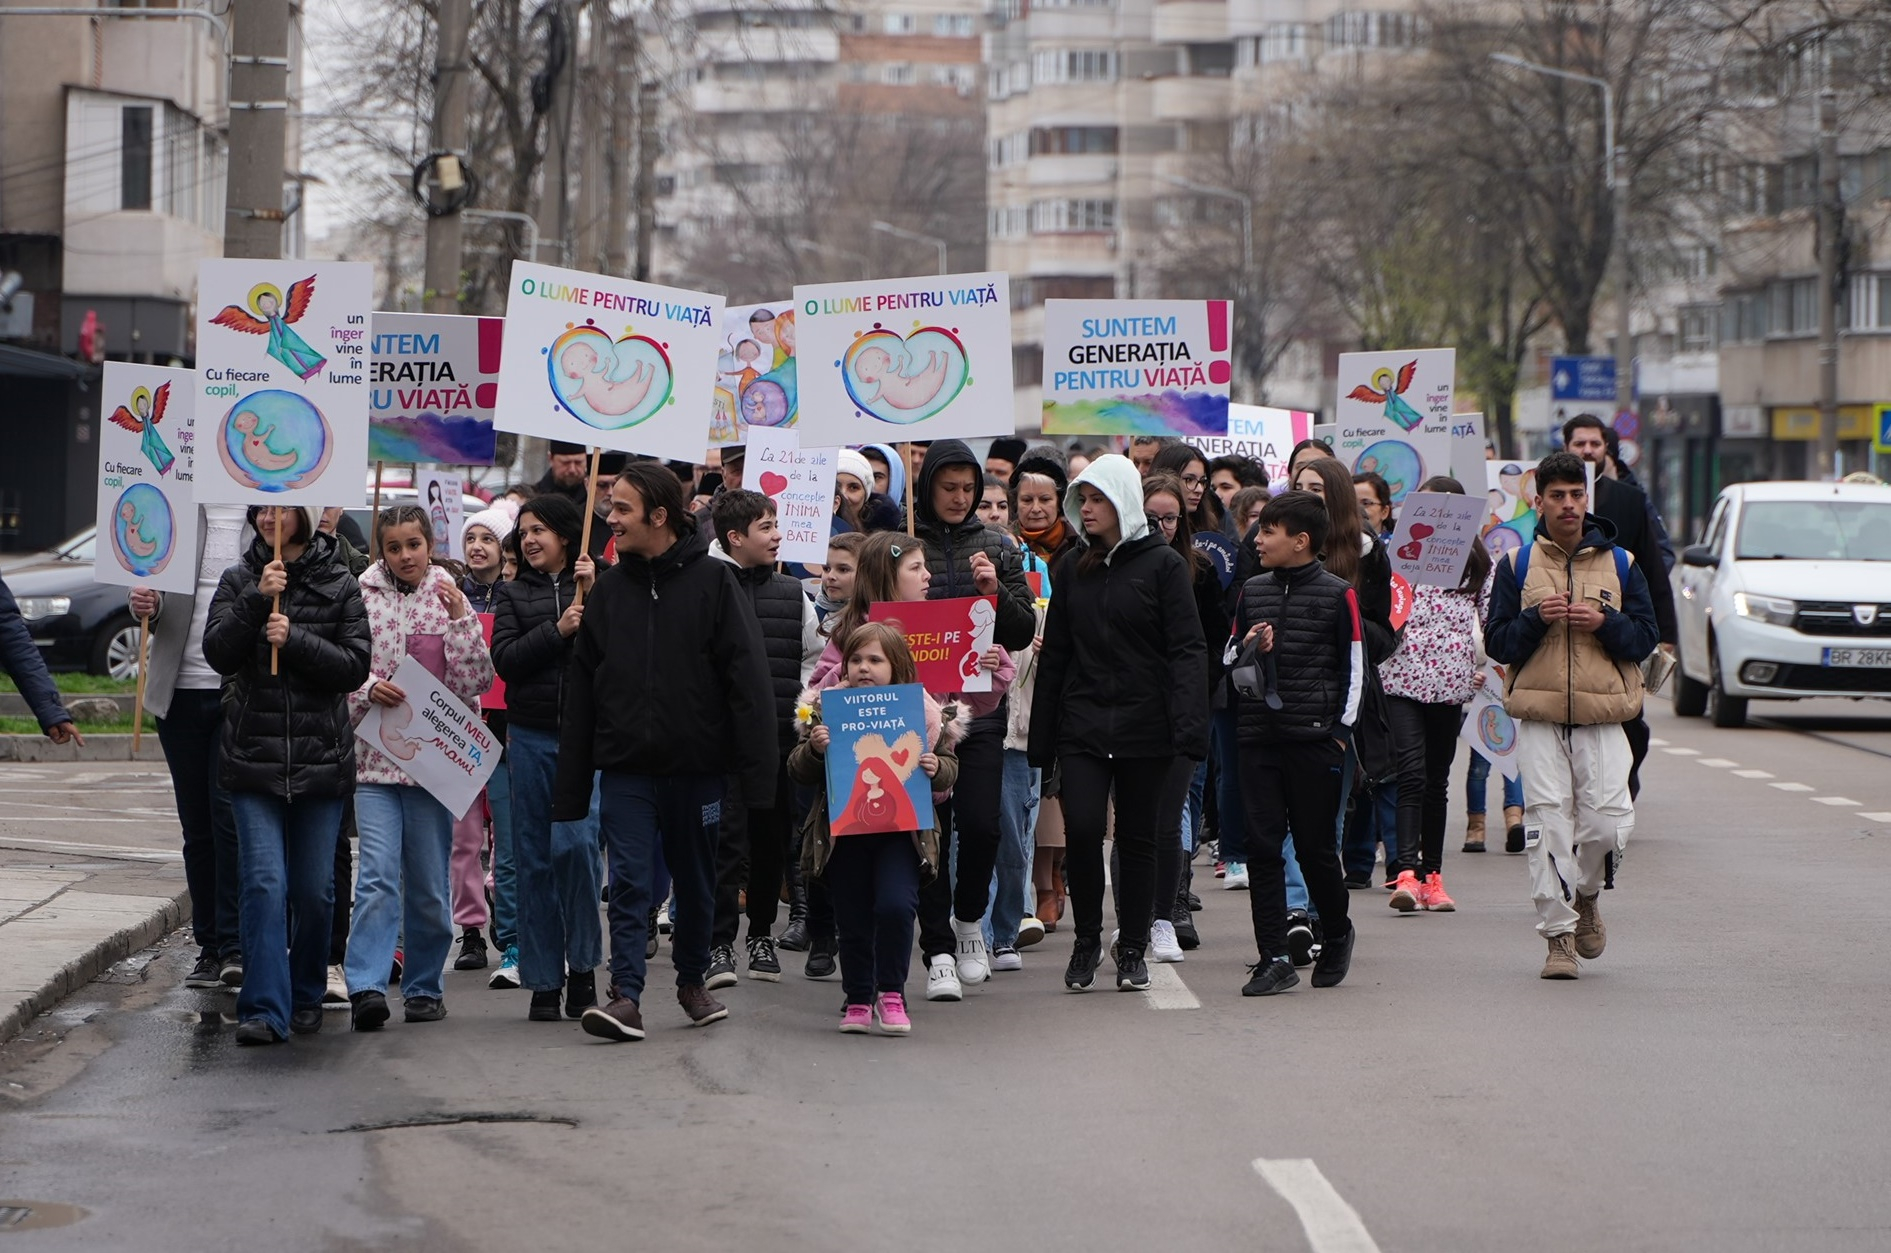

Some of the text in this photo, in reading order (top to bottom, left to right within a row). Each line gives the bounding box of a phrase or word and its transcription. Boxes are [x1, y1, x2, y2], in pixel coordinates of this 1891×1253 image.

[521, 278, 712, 328] O LUME PENTRU VIAȚĂ
[805, 283, 998, 316] O LUME PENTRU VIAȚĂ
[347, 314, 364, 324] un
[330, 326, 364, 342] înger
[1082, 316, 1176, 339] SUNTEM
[335, 342, 363, 354] vine
[1068, 342, 1191, 366] GENERAȚIA
[350, 357, 362, 369] în
[206, 368, 270, 382] Cu fiecare
[329, 371, 362, 384] lume
[370, 362, 456, 387] ERAȚIA
[1054, 361, 1207, 391] PENTRU VIAȚĂ
[205, 384, 239, 398] copil,
[1437, 384, 1449, 392] un
[397, 383, 472, 414] VIAȚĂ
[1426, 394, 1448, 404] înger
[1429, 404, 1448, 412] vine
[1438, 413, 1447, 422] în
[178, 428, 194, 442] înge
[1342, 428, 1386, 438] Cu fiecare
[1424, 425, 1447, 434] lume
[1452, 422, 1476, 439] AȚĂ
[1342, 438, 1365, 449] copil,
[760, 447, 775, 463] La
[779, 450, 793, 464] 21
[794, 453, 806, 464] de
[104, 462, 142, 476] Cu fiecare
[104, 476, 124, 489] copil,
[790, 470, 818, 482] de la
[1413, 506, 1426, 517] La
[1430, 508, 1442, 518] 21
[1443, 510, 1453, 518] de
[792, 520, 812, 528] mea
[1436, 522, 1461, 532] de la
[786, 530, 818, 543] BATE
[1401, 563, 1454, 574] deja BATE
[944, 630, 960, 644] PE
[910, 647, 950, 662] NDOI!
[1832, 651, 1852, 664] BR
[844, 692, 898, 705] VIITORUL
[858, 706, 887, 717] ESTE
[430, 690, 491, 754] Corpul MEU,
[842, 716, 906, 732] PRO-VIAȚĂ
[422, 707, 482, 767] alegerea TA,
[432, 737, 476, 776] mami
